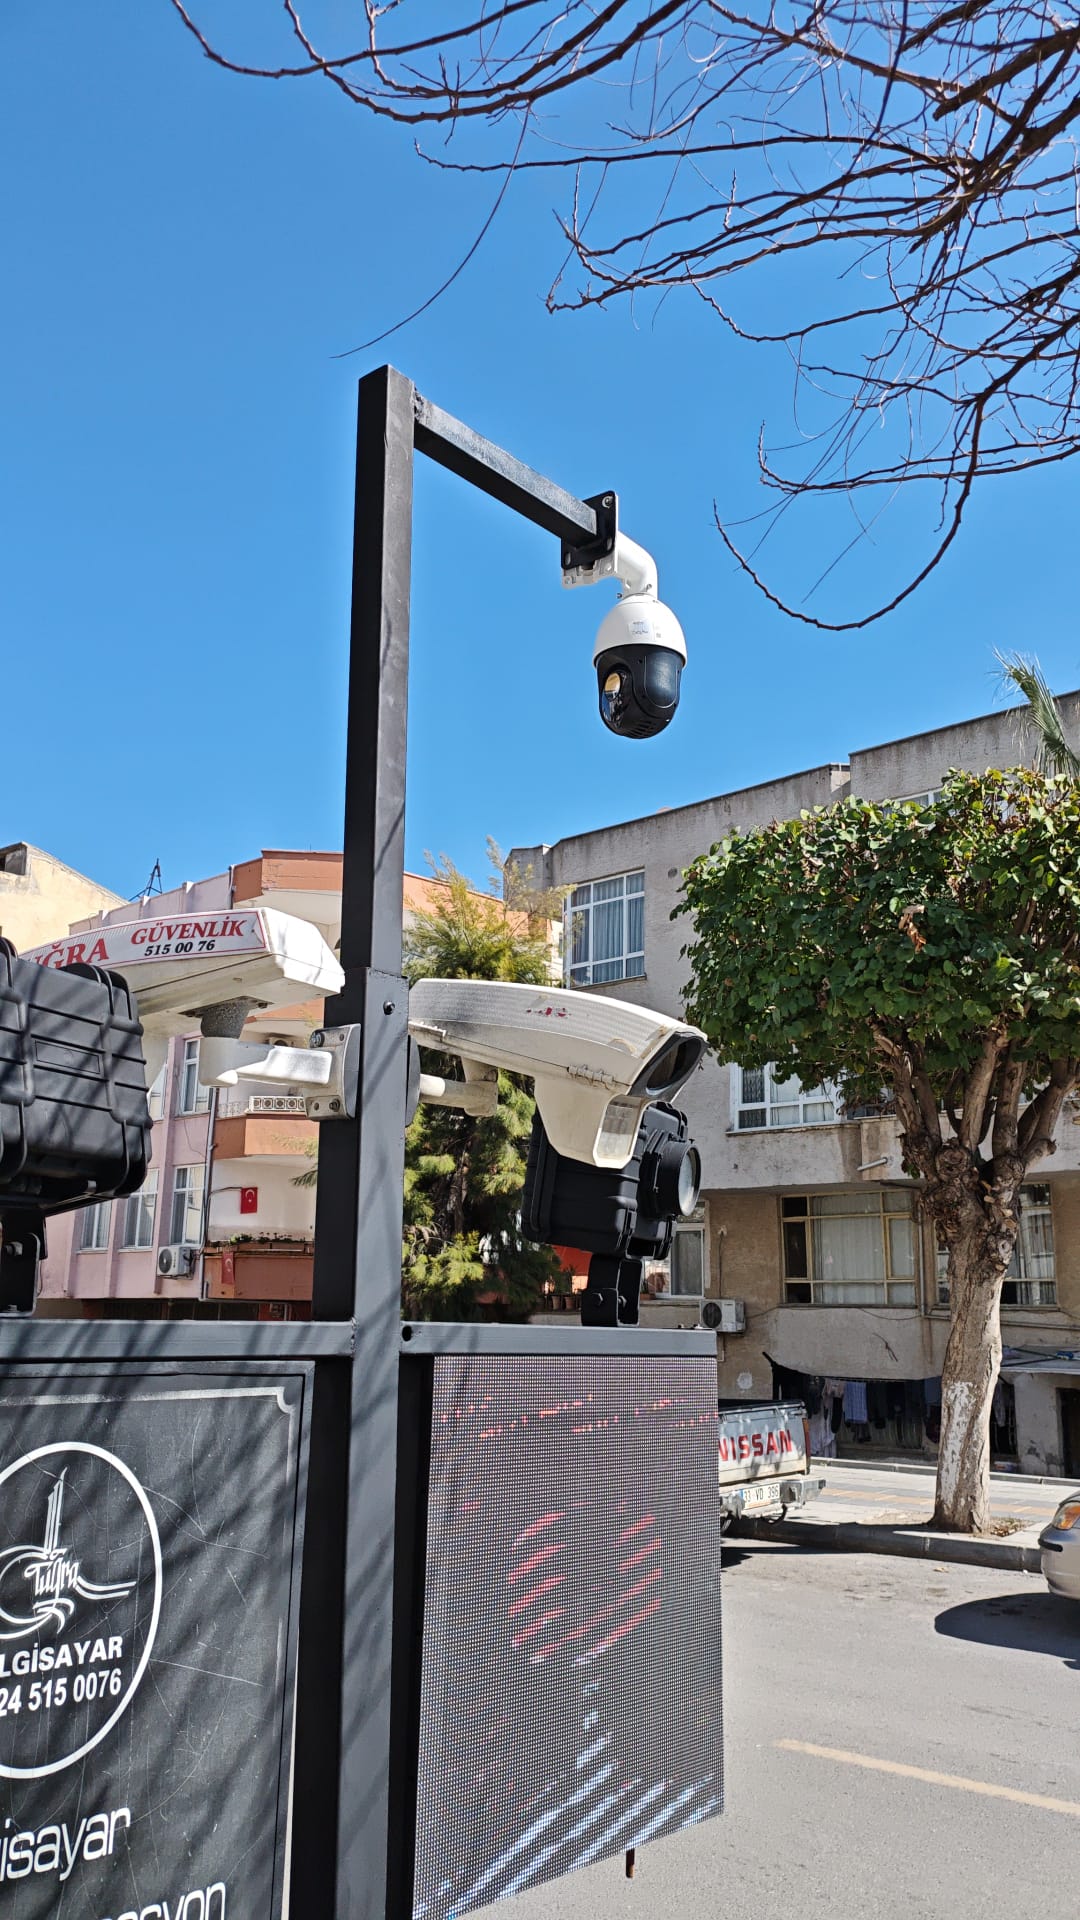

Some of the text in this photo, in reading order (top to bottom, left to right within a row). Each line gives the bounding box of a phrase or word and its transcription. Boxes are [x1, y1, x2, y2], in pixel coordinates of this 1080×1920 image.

[130, 916, 247, 945] GÜVENLİK
[144, 939, 216, 957] 515 00 76
[719, 1429, 792, 1461] NISSAN
[28, 1678, 67, 1711] 515
[73, 1668, 122, 1703] 0076
